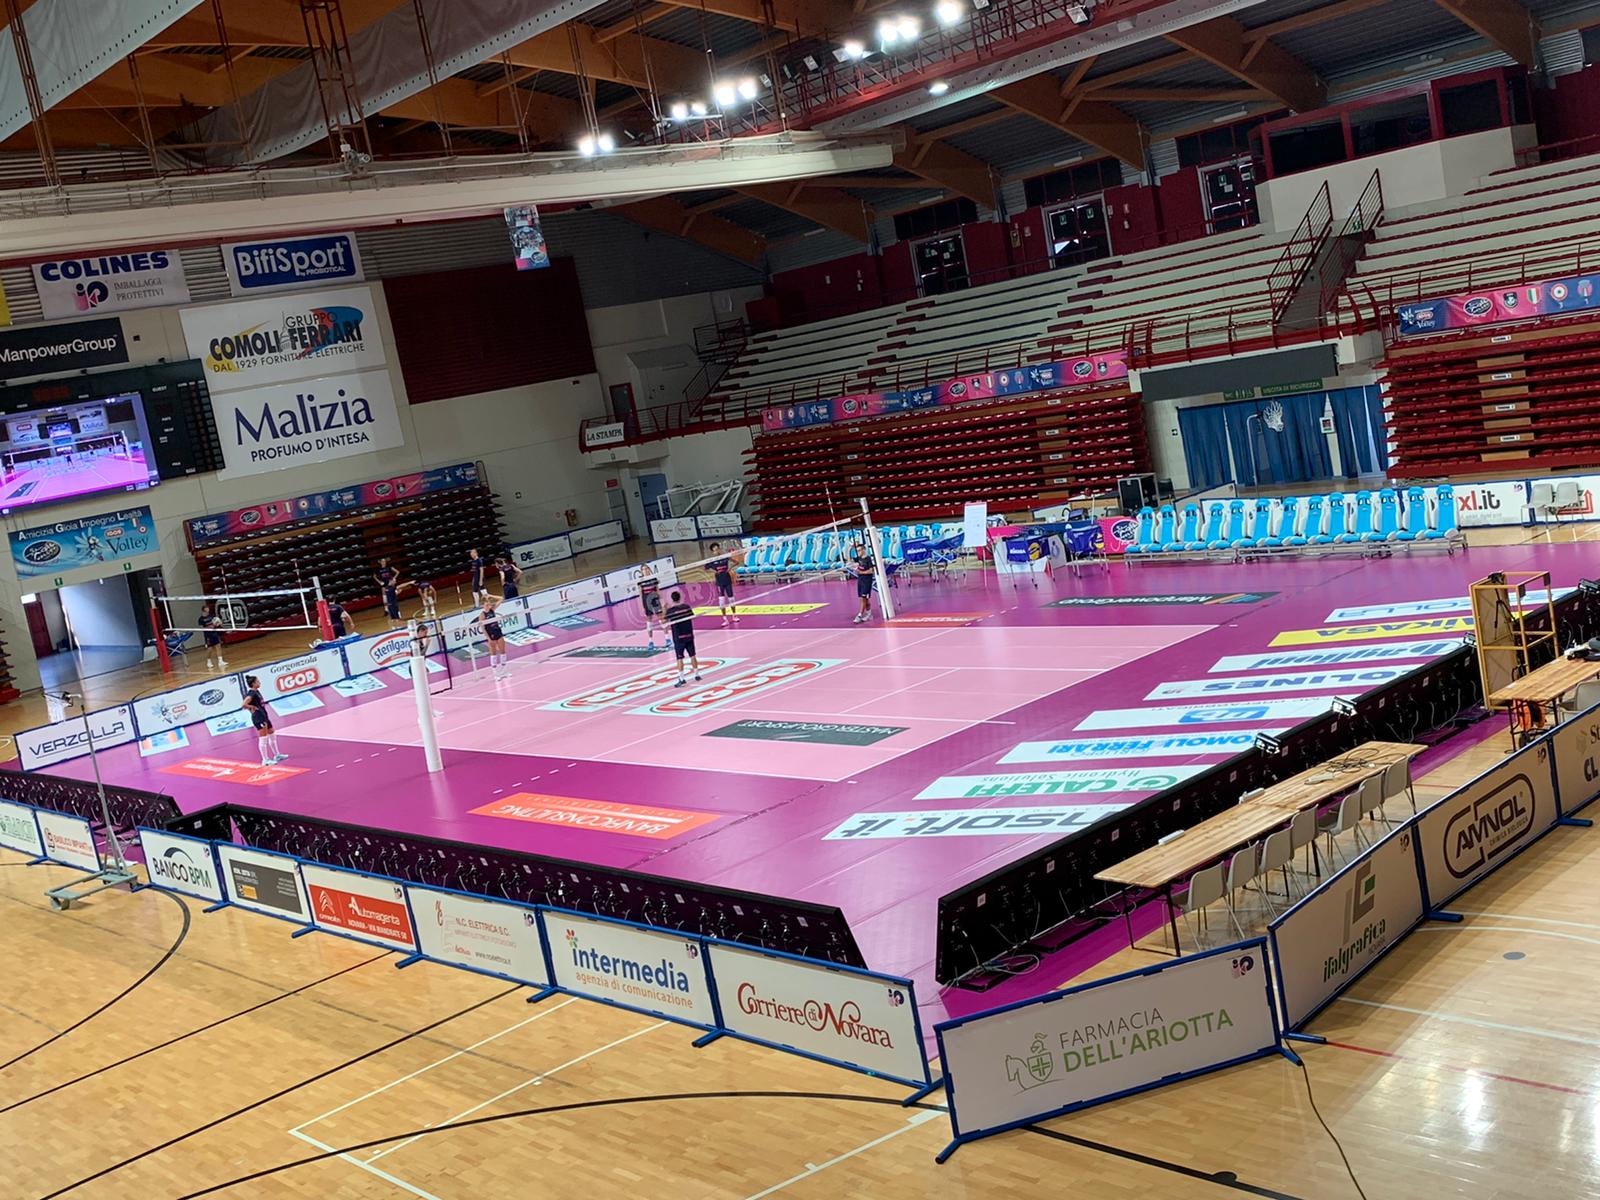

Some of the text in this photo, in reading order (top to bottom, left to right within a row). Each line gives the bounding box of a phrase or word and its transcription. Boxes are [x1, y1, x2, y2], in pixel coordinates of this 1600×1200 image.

[41, 251, 169, 282] COLINES
[237, 241, 345, 276] BifiSport
[306, 266, 346, 276] PROBIOTICAL
[114, 277, 162, 291] IMBALLAGGI
[116, 288, 165, 301] PROTETTIVI
[286, 312, 338, 328] GRUPPO
[209, 320, 364, 362] COMOLI FERRARI
[214, 343, 365, 373] DAL 1929 FORNITURE ELETTRICHE
[235, 388, 375, 446] Malizia
[251, 431, 370, 462] PROFUMO D'INTESA
[587, 428, 622, 441] LA STAMPA
[18, 528, 54, 541] Amicizia
[55, 521, 78, 533] Gioia
[80, 514, 115, 528] Impegno
[107, 536, 149, 555] Volley
[454, 625, 483, 641] BANC
[270, 654, 318, 674] Gorgonzola
[279, 673, 317, 691] IGOR
[667, 666, 805, 708] IGOR
[1204, 671, 1405, 692] OLINES
[30, 721, 125, 756] VERZOLLA
[1047, 734, 1250, 754] OMOLI FERRARI
[964, 779, 1110, 798] CALEFFI
[983, 769, 1141, 783] Hydronic Solutions
[1456, 794, 1526, 859] AMNOL
[153, 857, 188, 882] BANCO
[188, 866, 212, 888] BPM
[469, 919, 498, 933] ELETTRICA
[573, 947, 689, 993] intermedia
[576, 972, 693, 1008] agenzia di comunicazione
[737, 982, 894, 1049] Corriere di Novara
[1059, 1007, 1164, 1049] FARMACIA
[1063, 1008, 1234, 1073] DELL'ARIOTTA
